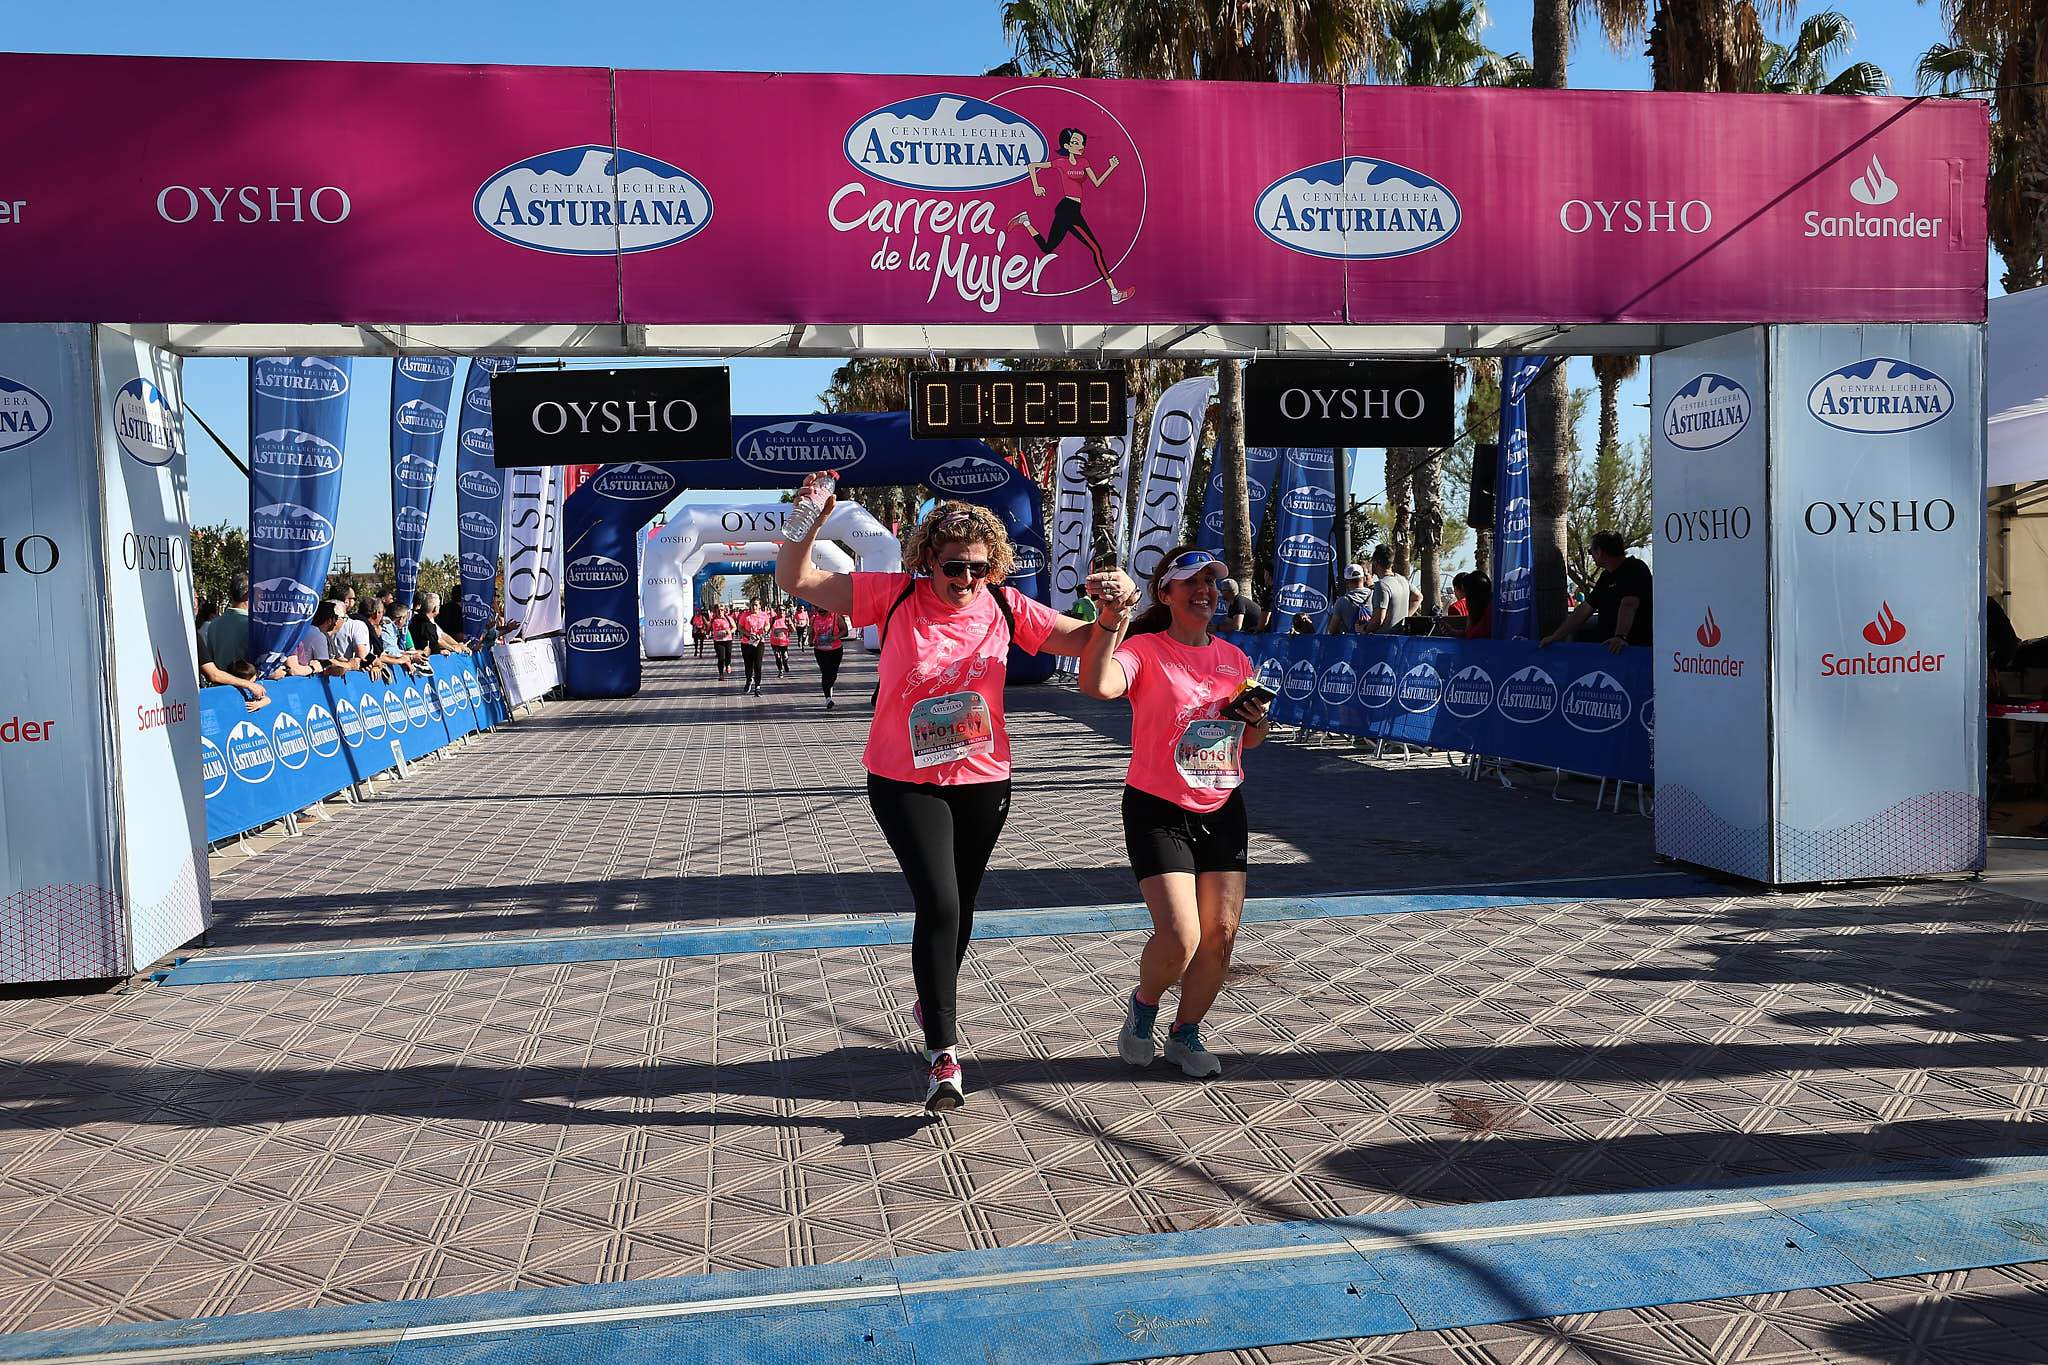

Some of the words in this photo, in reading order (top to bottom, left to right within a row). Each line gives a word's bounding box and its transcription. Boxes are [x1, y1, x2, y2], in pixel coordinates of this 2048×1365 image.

[891, 126, 957, 137] CENTRAL
[962, 128, 1026, 138] LECHERA
[861, 127, 1030, 167] ASTURIANA
[529, 183, 604, 194] CENTRAL
[1302, 192, 1367, 202] CENTRAL
[1373, 192, 1438, 203] LECHERA
[156, 186, 351, 224] OYSHO
[493, 185, 695, 226] ASTURIANA
[828, 182, 997, 235] Carrera
[1271, 193, 1445, 233] ASTURIANA
[1559, 199, 1712, 234] OYSHO
[1804, 210, 1943, 239] Santander
[870, 237, 902, 272] de
[908, 235, 931, 273] la
[926, 231, 1058, 313] Mujer
[256, 367, 340, 392] ASTURIANA
[1840, 383, 1887, 394] CENTRAL
[1890, 383, 1938, 393] LECHERA
[1279, 388, 1425, 420] OYSHO
[1680, 400, 1708, 412] CENTRAL
[1709, 392, 1741, 406] LECHERA
[1817, 386, 1943, 416] ASTURIANA
[119, 402, 175, 449] ASTURIANA
[531, 399, 698, 435] OYSHO
[1668, 403, 1744, 437] ASTURIANA
[746, 438, 857, 461] ASTURIANA
[766, 435, 808, 443] CENTRAL
[810, 435, 853, 443] LECHERA
[1291, 448, 1334, 464] ASTURIA
[597, 477, 669, 491] ASTURIANA
[936, 472, 1005, 486] ASTURIANA
[1133, 409, 1195, 581] OYSHO
[721, 511, 788, 532] OYS
[1664, 505, 1751, 544] OYSHO
[1804, 498, 1956, 536] OYSHO
[253, 521, 326, 543] STURIANA
[508, 468, 557, 606] OYSH
[660, 536, 692, 544] OYSHO
[122, 532, 184, 573] OYSHO
[568, 568, 625, 582] ASTURIANA
[647, 577, 677, 586] OYSHO
[253, 600, 314, 615] STURANA
[569, 629, 625, 643] ASTURIANA
[648, 618, 678, 627] OYSHO
[1673, 651, 1744, 678] Santander
[1821, 650, 1946, 677] Santander
[1500, 686, 1552, 710] ASTURIANA
[1565, 691, 1622, 720] ASTURIANA
[137, 702, 187, 731] Santander
